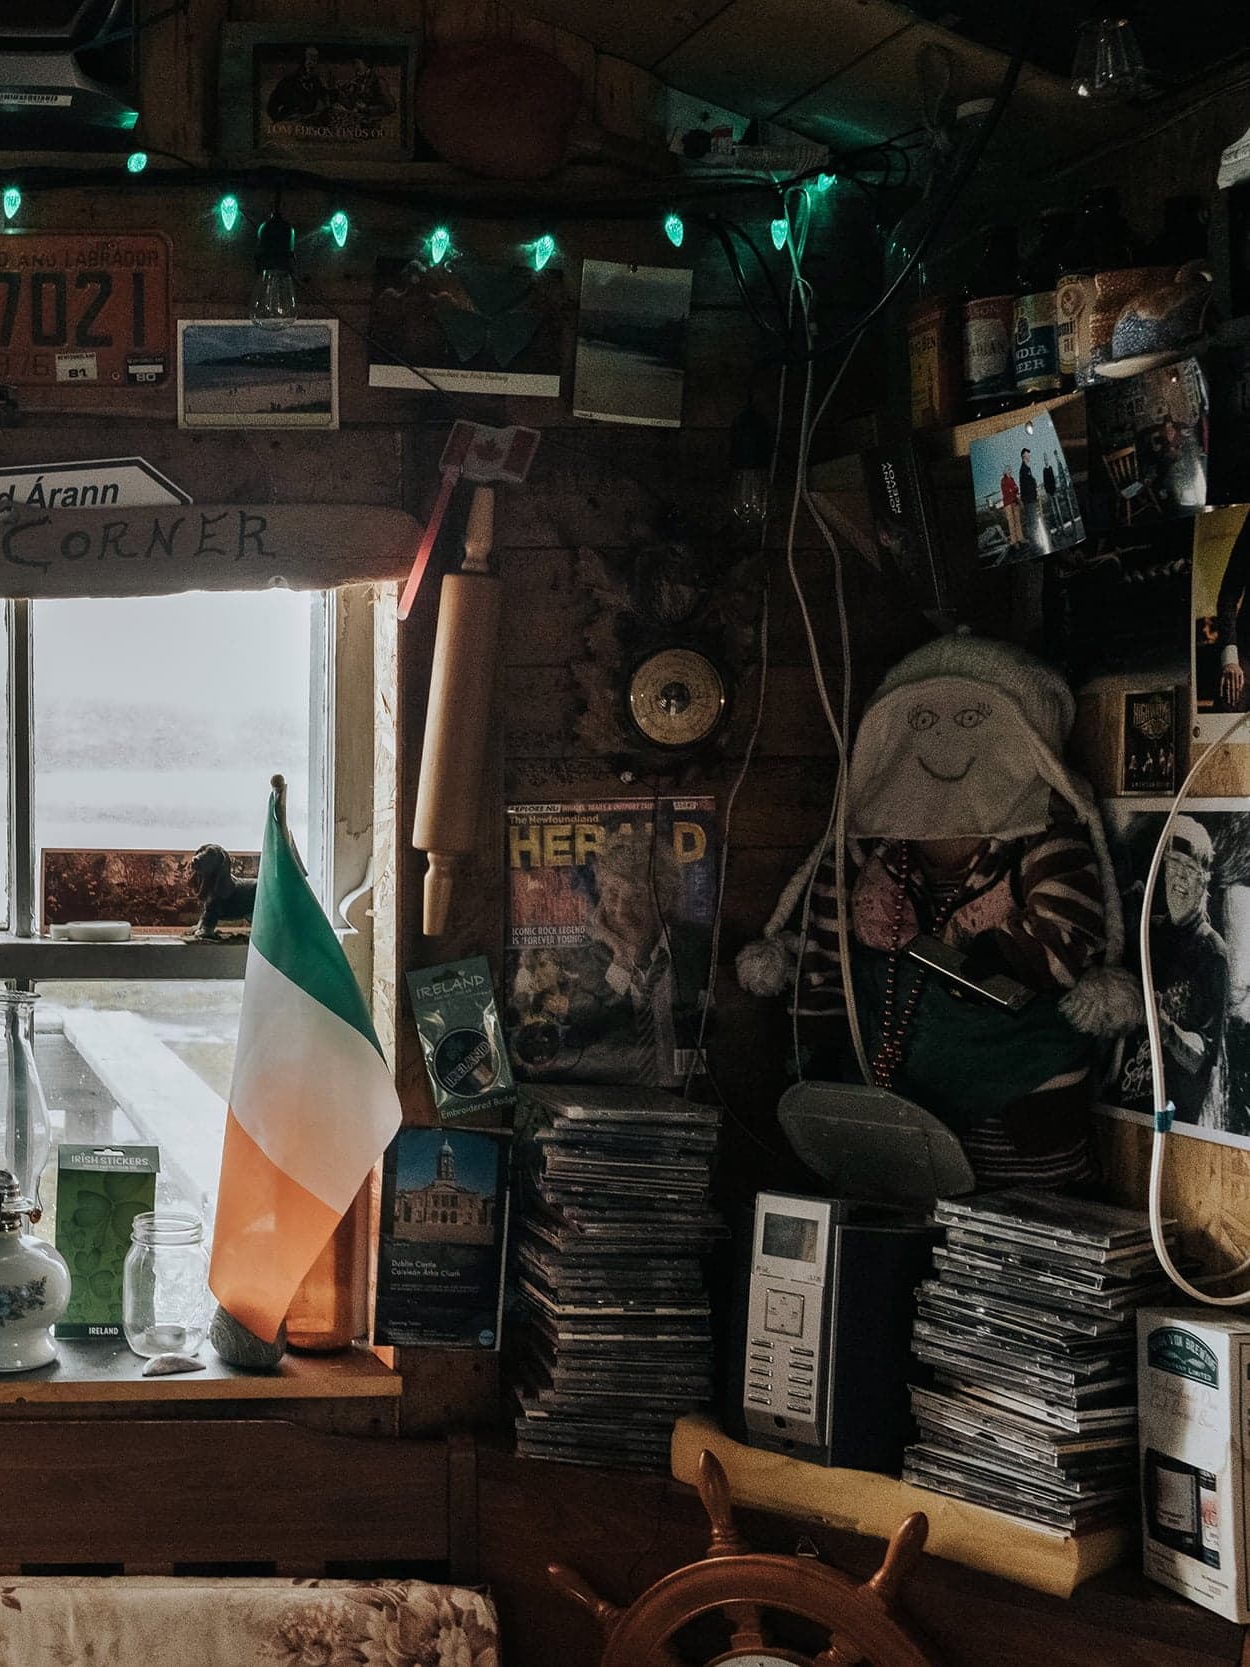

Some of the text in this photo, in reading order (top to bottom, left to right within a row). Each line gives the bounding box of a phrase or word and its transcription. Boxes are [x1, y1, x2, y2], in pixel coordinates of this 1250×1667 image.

[68, 368, 87, 378] 81
[136, 372, 157, 382] 80
[25, 476, 119, 508] Árann
[2, 510, 277, 575] CORNER
[510, 814, 599, 825] The Newfoundland
[509, 821, 707, 869] HERD
[416, 975, 485, 1000] IRELAND
[445, 1040, 491, 1089] IRELAND
[441, 1100, 493, 1120] Embroidered
[71, 1154, 98, 1164] IRISH
[100, 1156, 149, 1166] STICKERS
[89, 1327, 119, 1335] IRELAND
